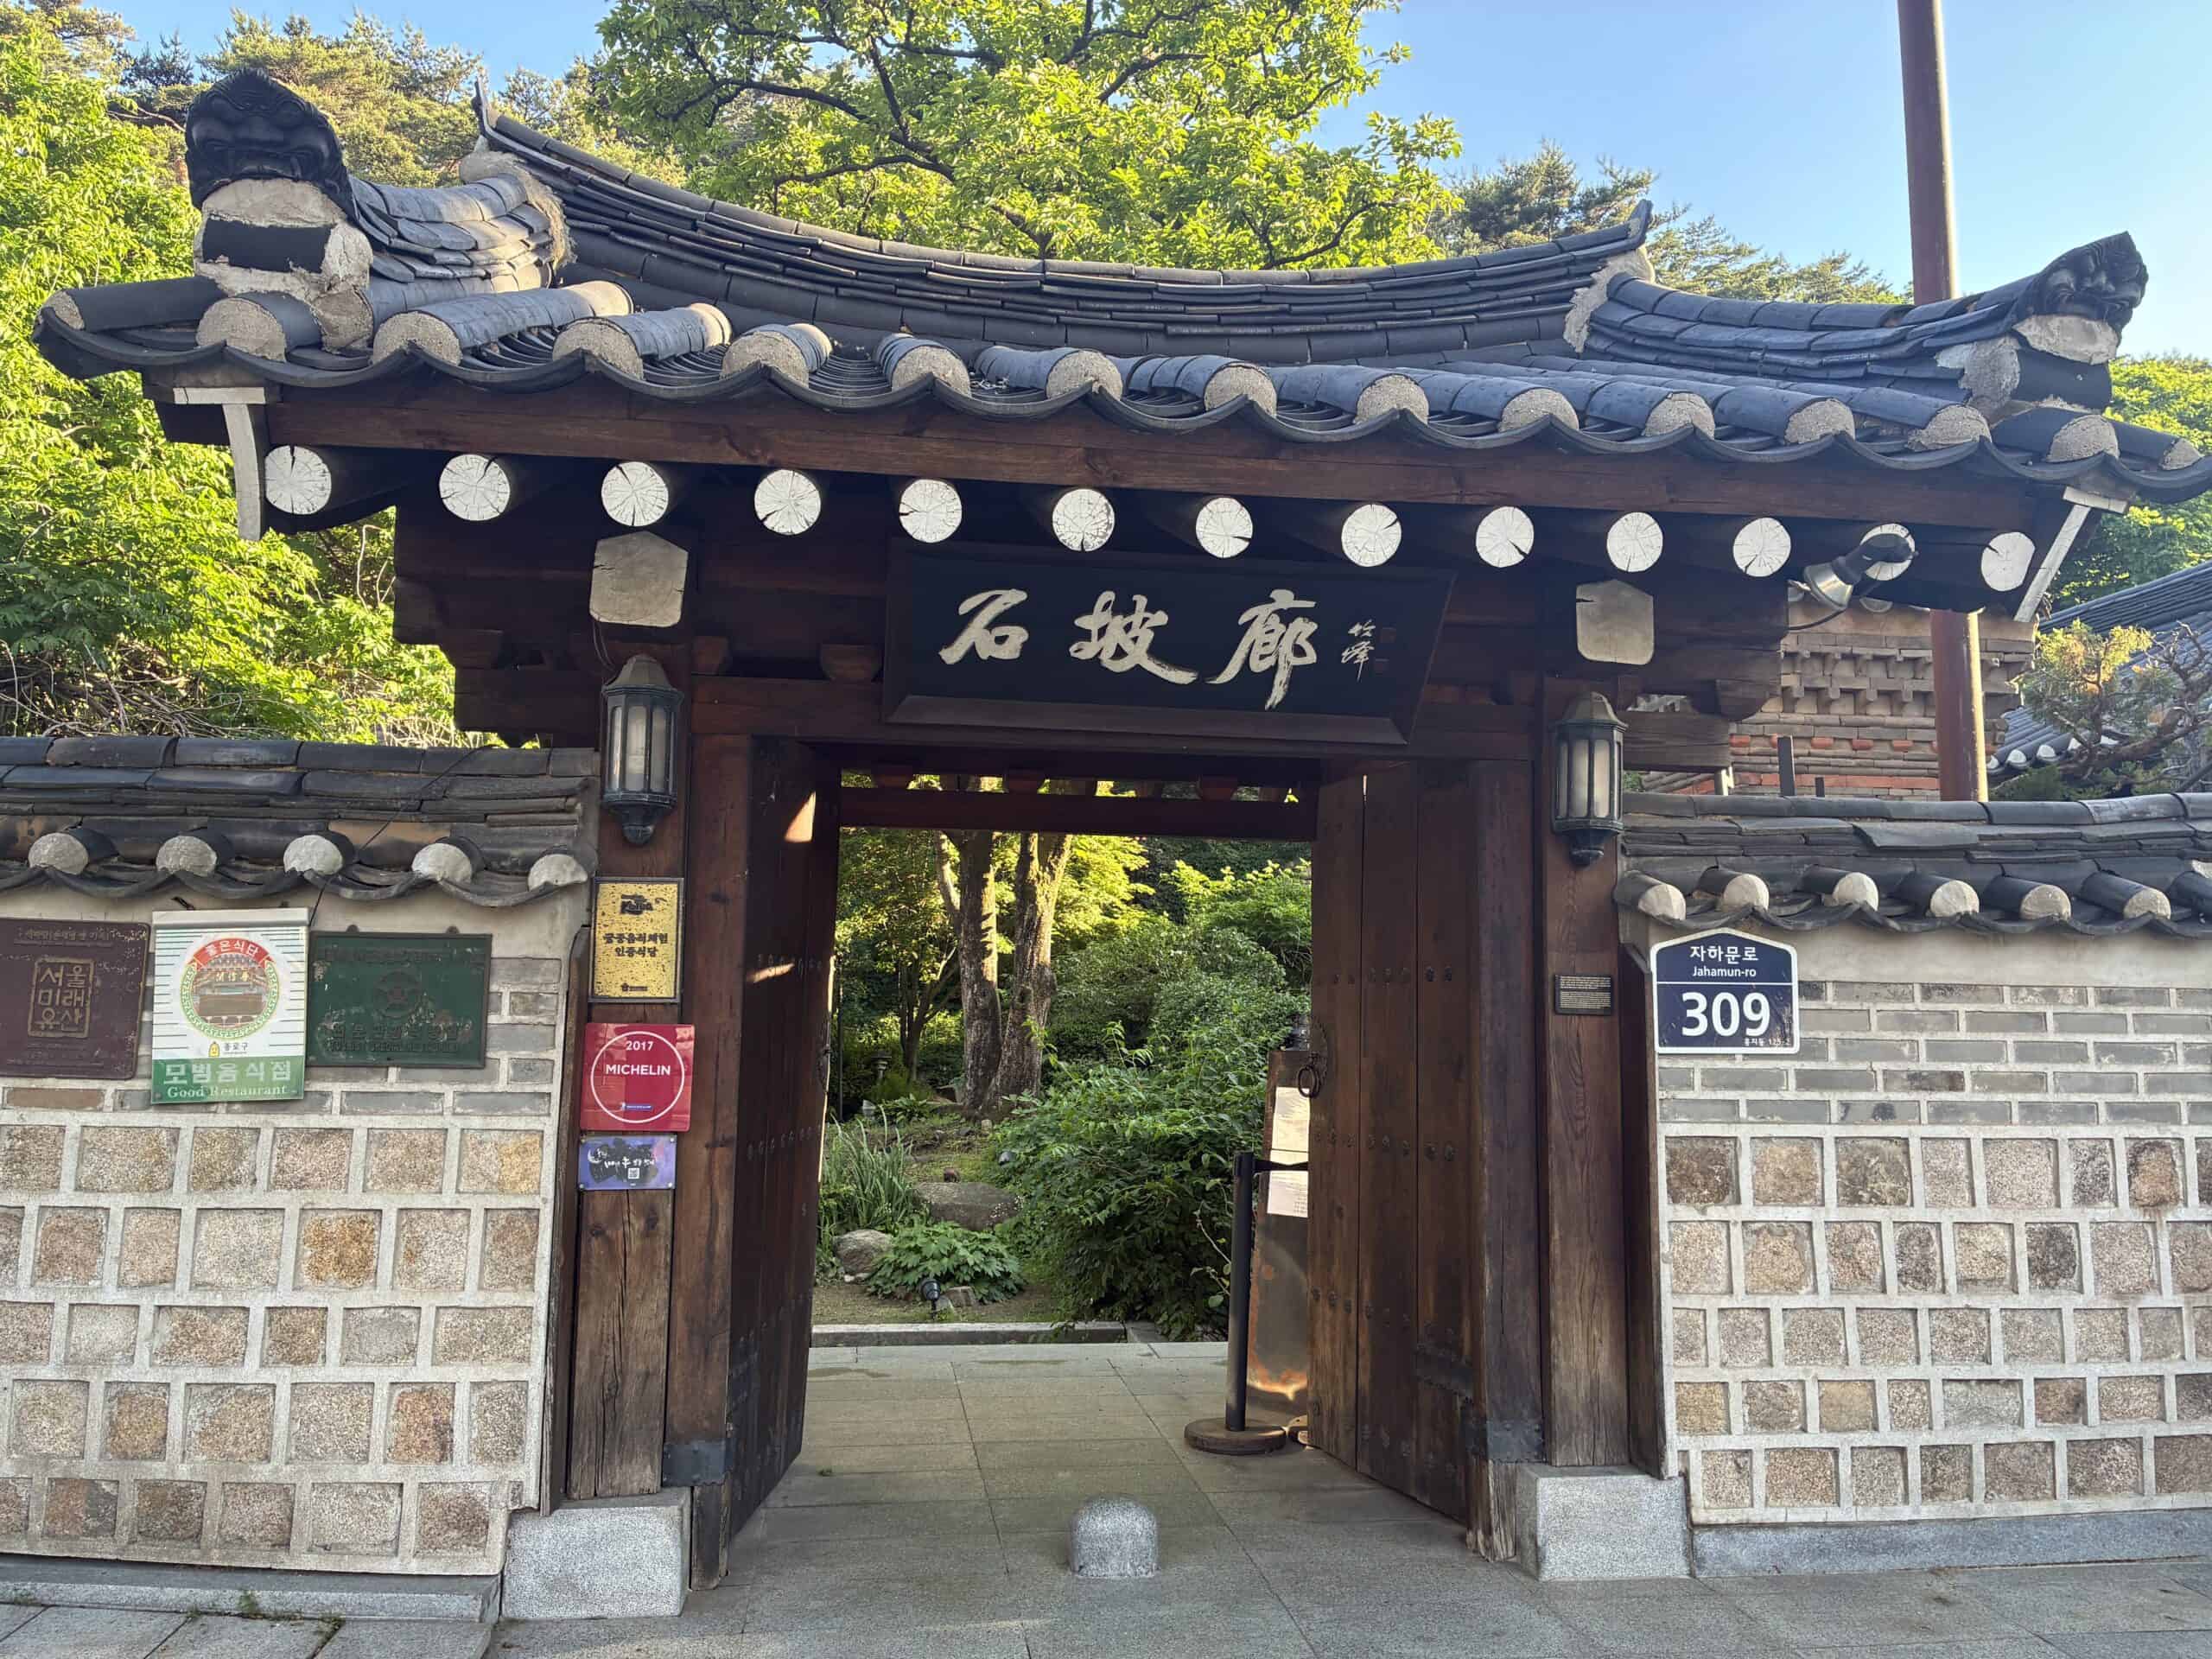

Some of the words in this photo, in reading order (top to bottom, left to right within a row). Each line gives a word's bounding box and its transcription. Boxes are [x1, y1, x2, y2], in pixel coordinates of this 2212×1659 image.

[1690, 946, 1758, 963] 자하문로
[40, 965, 86, 988] 서울
[1693, 966, 1757, 977] Jahamun-ro
[38, 988, 85, 1007] 미래
[34, 1007, 84, 1032] 유산
[1681, 992, 1770, 1037] 309
[626, 1040, 653, 1051] 2017
[163, 1060, 290, 1084] 모범음식점
[606, 1064, 671, 1076] MICHELIN
[167, 1084, 205, 1098] Good
[209, 1084, 288, 1096] Restaurant
